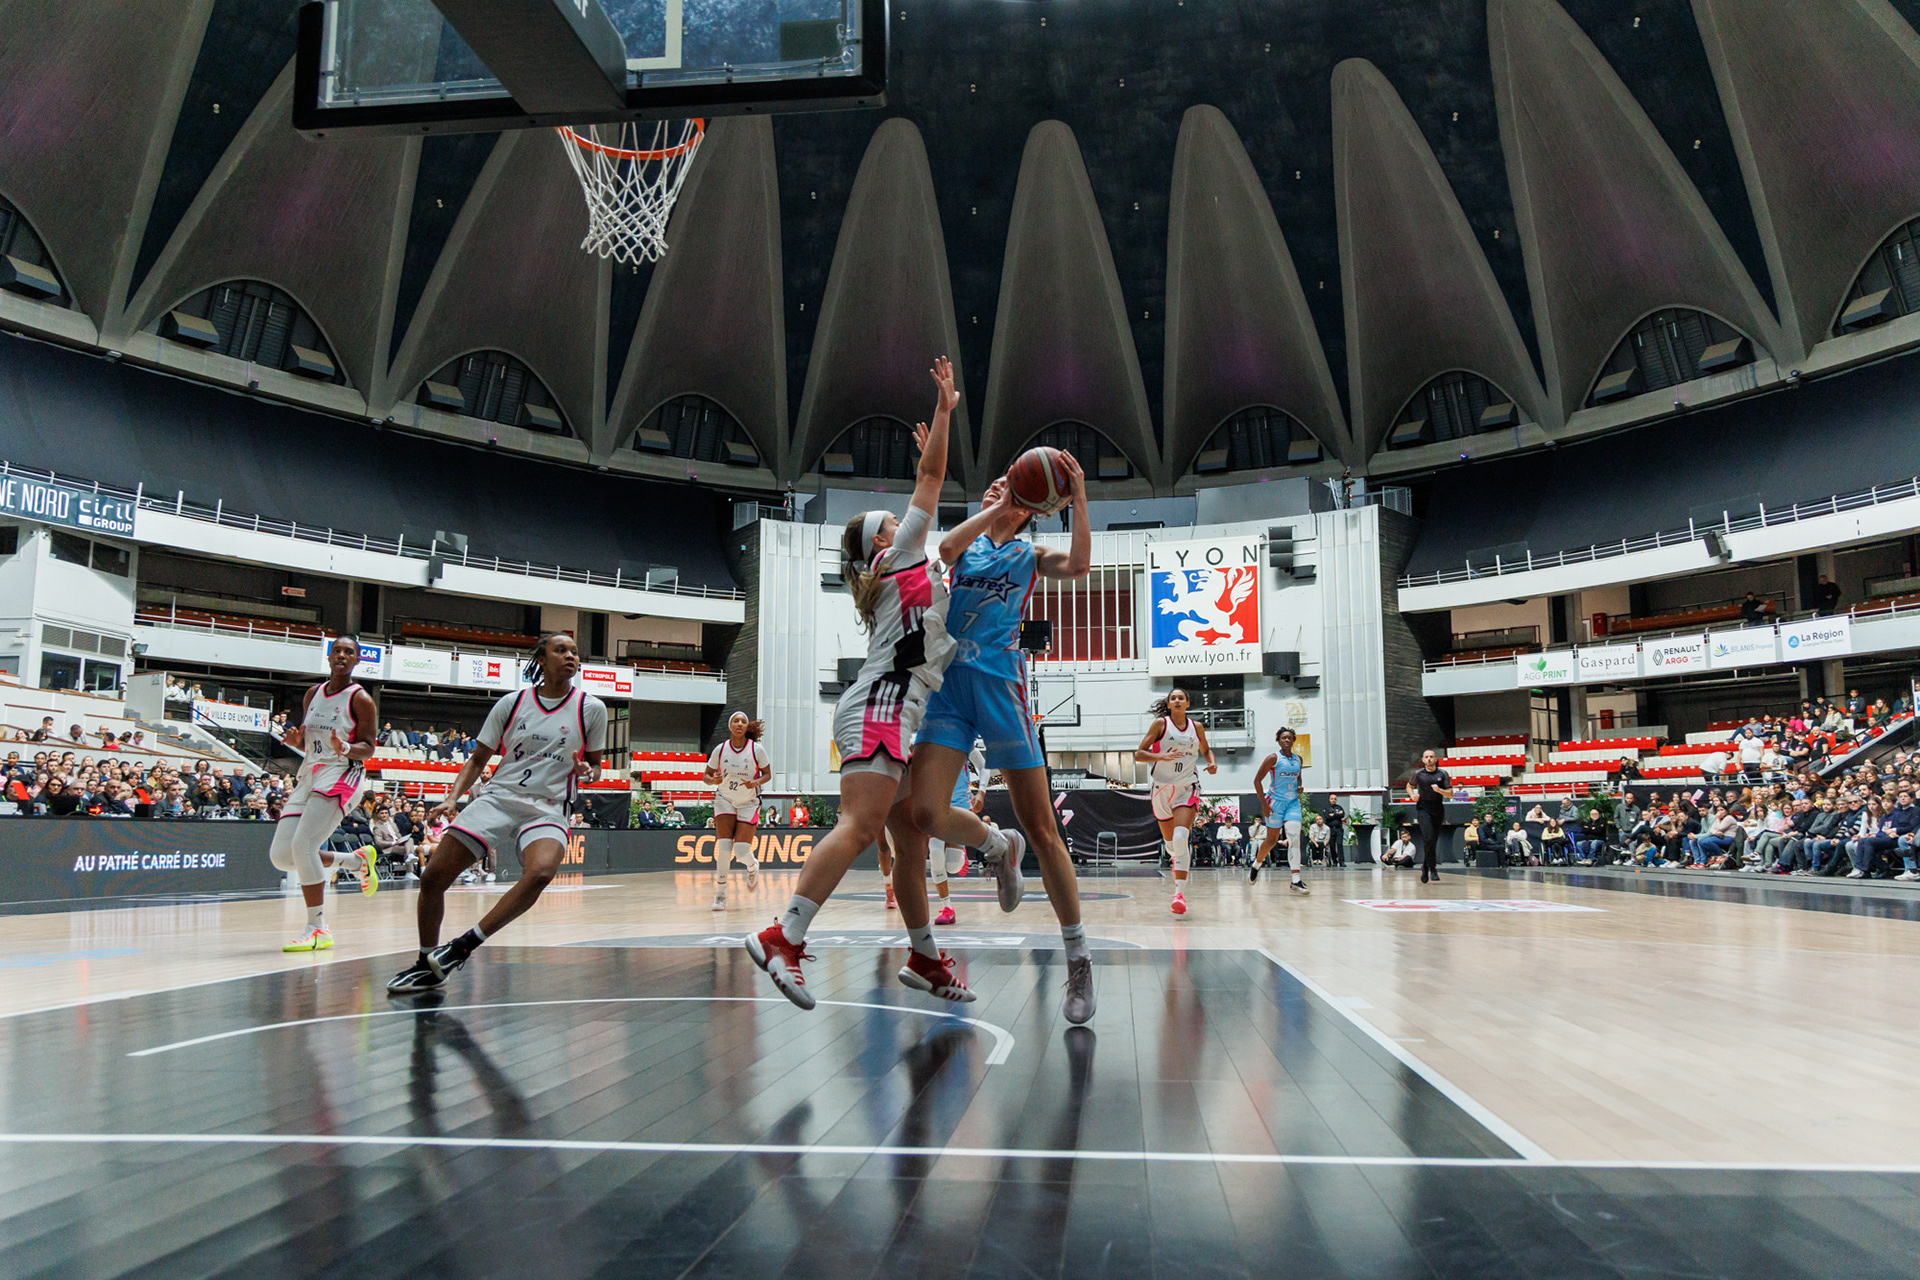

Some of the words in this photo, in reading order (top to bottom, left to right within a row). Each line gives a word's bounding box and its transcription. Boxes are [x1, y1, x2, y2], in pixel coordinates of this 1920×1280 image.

[20, 483, 70, 519] NORD
[79, 498, 134, 522] ciril
[93, 517, 133, 533] GROUP
[1150, 544, 1258, 570] LYON
[960, 611, 980, 634] 7
[1801, 634, 1811, 642] La
[1812, 630, 1844, 640] Région
[1663, 644, 1701, 655] RENAULT
[1730, 644, 1755, 653] BILANIS
[1165, 648, 1252, 667] www.lyon.fr
[1580, 653, 1635, 670] Gaspard
[1665, 656, 1689, 665] ARGG
[1523, 672, 1542, 681] AGG
[1542, 669, 1568, 680] PRINT
[210, 710, 227, 720] VILLE
[227, 712, 236, 721] DE
[237, 713, 254, 723] LYON
[1174, 762, 1184, 773] 10
[518, 768, 532, 787] 2
[728, 780, 739, 791] 32
[674, 834, 813, 863] SCING
[73, 854, 96, 872] AU
[98, 851, 139, 871] PATHÉ
[141, 850, 181, 870] CARRÉ
[182, 853, 199, 869] DE
[200, 853, 226, 868] SOIE
